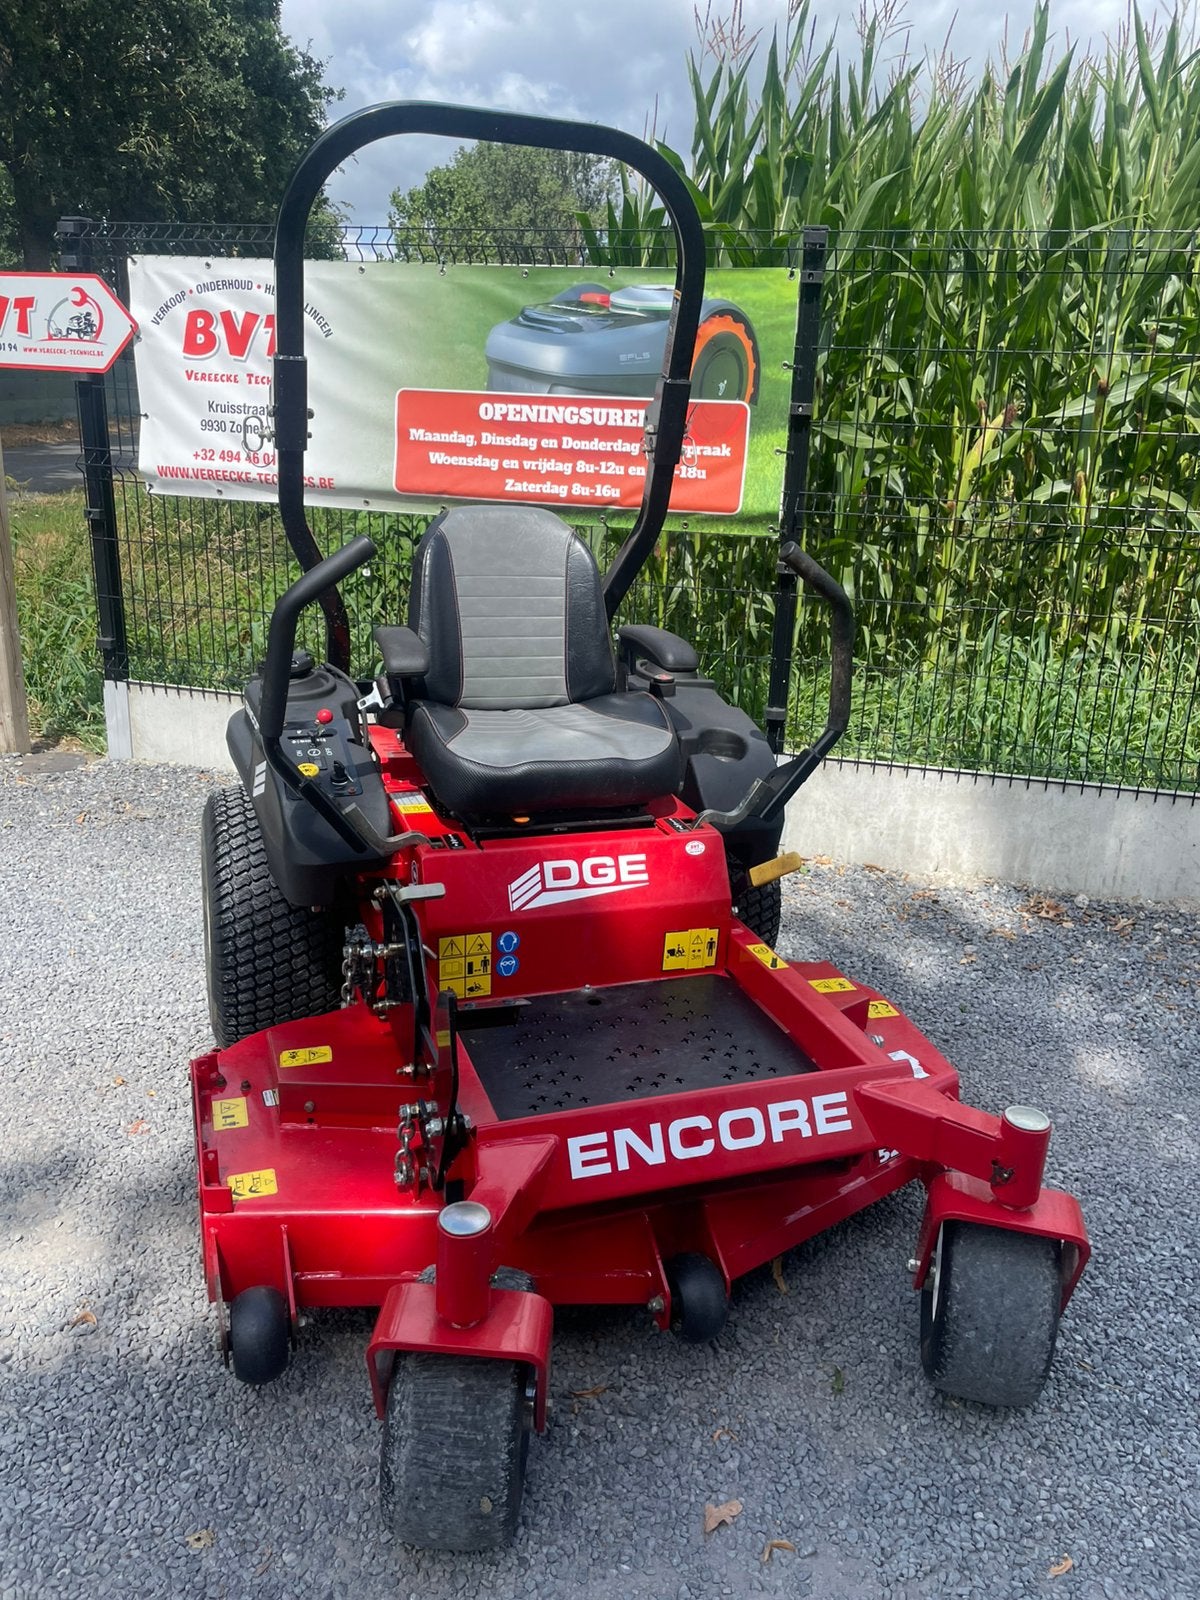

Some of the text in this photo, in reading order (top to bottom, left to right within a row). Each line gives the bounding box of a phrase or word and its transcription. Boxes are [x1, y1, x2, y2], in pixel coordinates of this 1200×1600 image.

[150, 290, 187, 326] VERKOOP
[195, 279, 253, 295] ONDERHOUD
[7, 342, 18, 352] 94
[200, 420, 227, 433] 9930
[409, 428, 477, 446] Maandag,
[481, 432, 537, 450] Dinsdag
[541, 438, 558, 449] en
[561, 436, 640, 456] Donderdag
[193, 448, 215, 461] +32
[218, 450, 241, 463] 494
[428, 451, 499, 471] Woensdag
[502, 459, 519, 470] en
[523, 458, 572, 475] vrijdag
[575, 460, 625, 475] 8u-12u
[628, 465, 646, 476] en
[505, 479, 621, 498] Zaterdag 8u-16u
[567, 1091, 853, 1180] ENCORE
